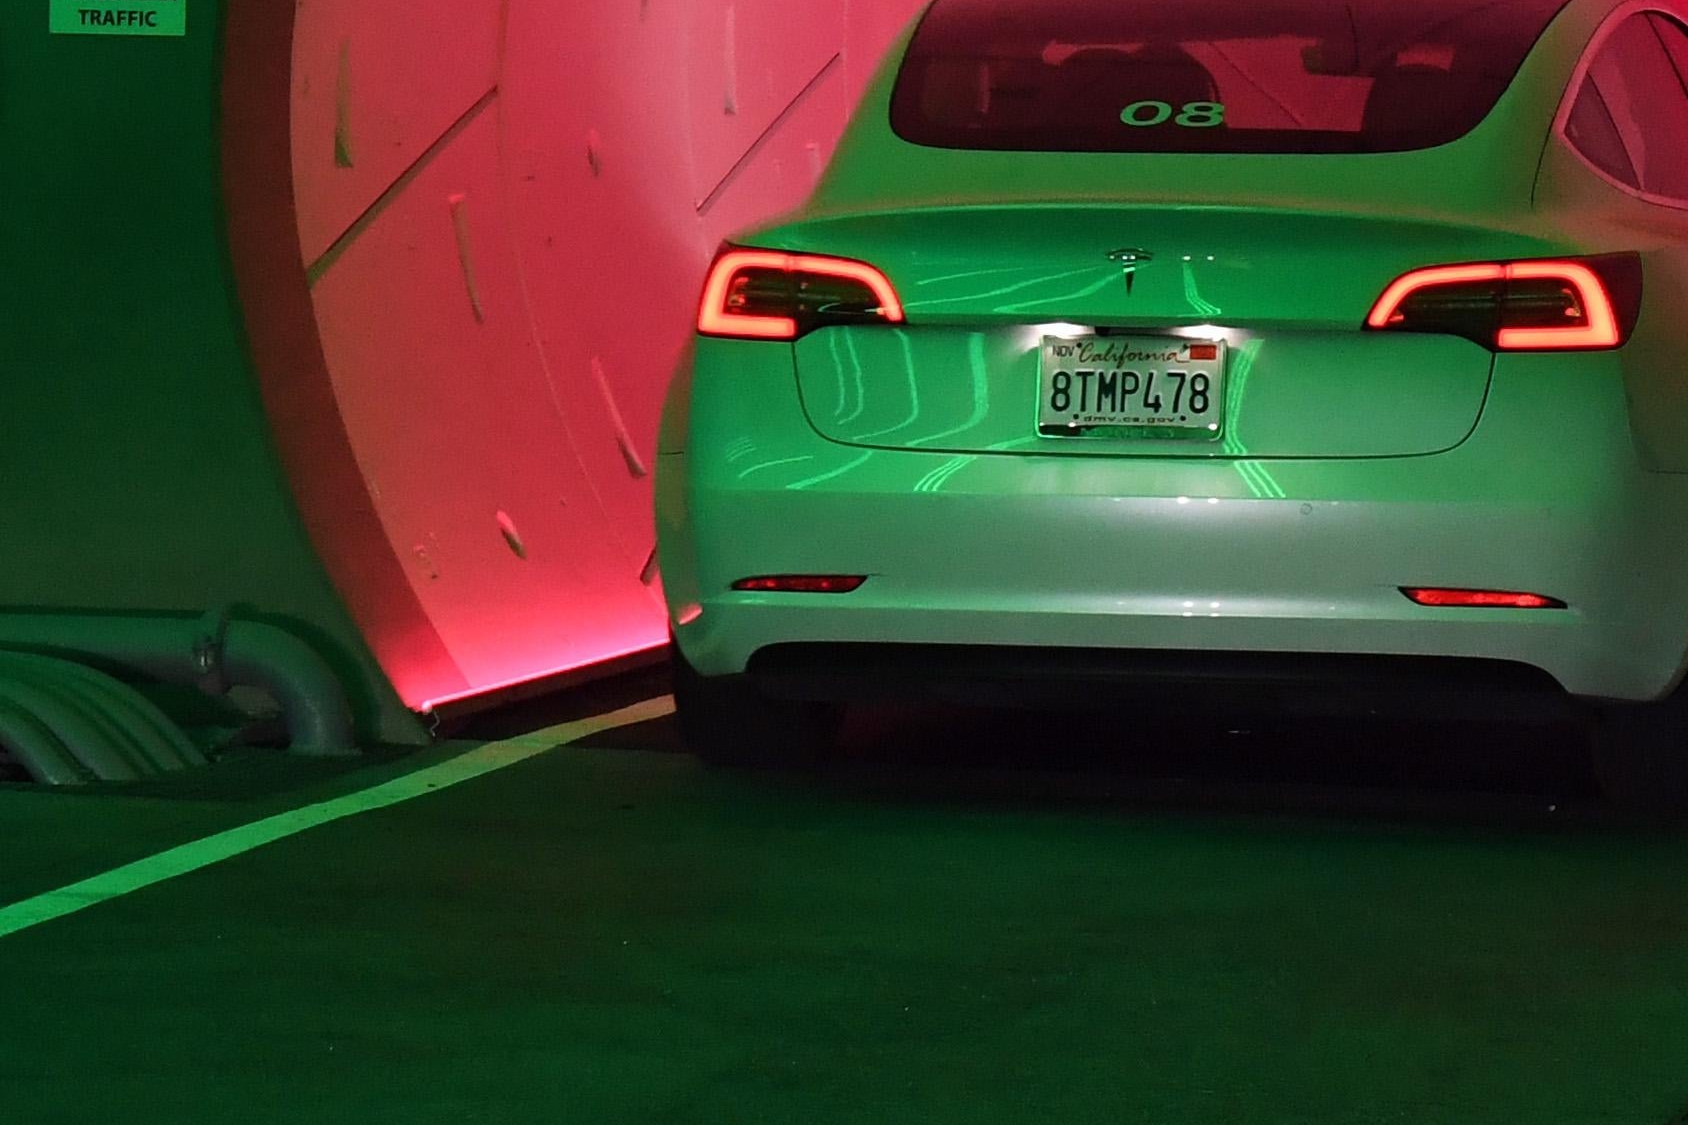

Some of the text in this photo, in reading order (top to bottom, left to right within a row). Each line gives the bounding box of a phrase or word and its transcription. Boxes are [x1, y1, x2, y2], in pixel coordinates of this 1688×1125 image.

[78, 9, 158, 27] TRAFFIC
[1119, 100, 1225, 127] 08
[1052, 342, 1191, 369] NOV California
[1051, 371, 1210, 414] 8TMP478
[1083, 413, 1176, 424] dmv.ca.gov
